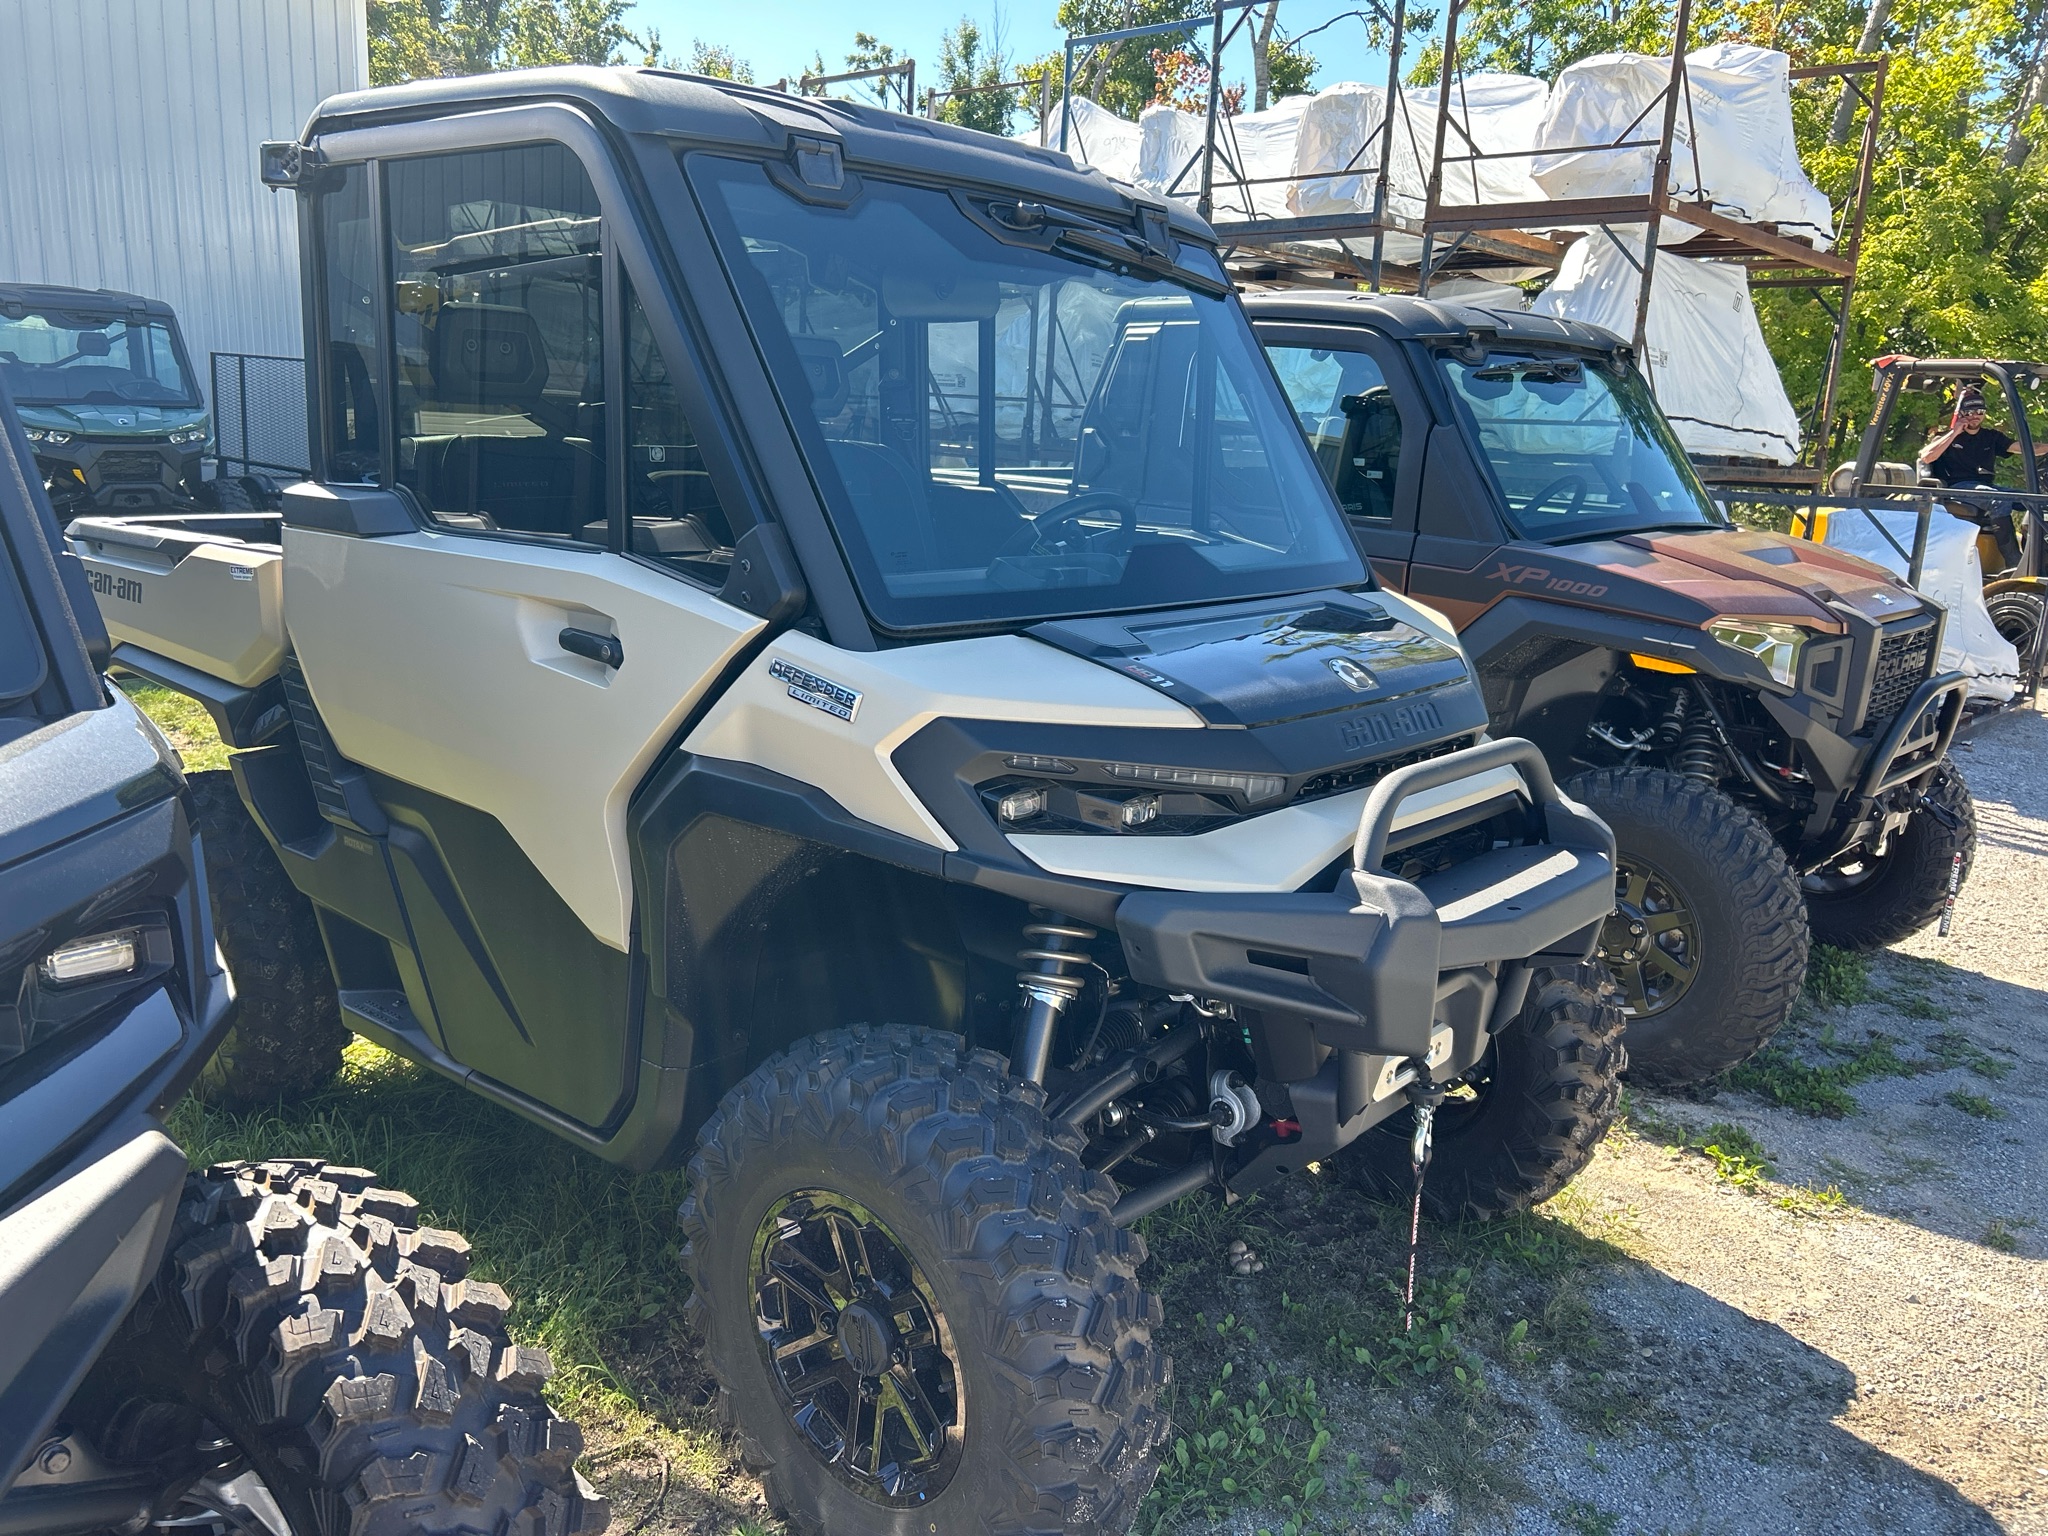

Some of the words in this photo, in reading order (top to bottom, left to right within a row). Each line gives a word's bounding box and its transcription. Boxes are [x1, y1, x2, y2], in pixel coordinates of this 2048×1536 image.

[1869, 392, 1888, 426] Veracitor
[230, 566, 254, 575] EXTREME
[1485, 562, 1551, 584] XP
[1545, 577, 1609, 598] 1000
[771, 660, 857, 707] DEFENDER
[1876, 648, 1928, 682] POLARIS
[1337, 701, 1444, 752] can-am
[1949, 851, 1962, 893] EXTREME
[1941, 894, 1956, 934] EXTREME
